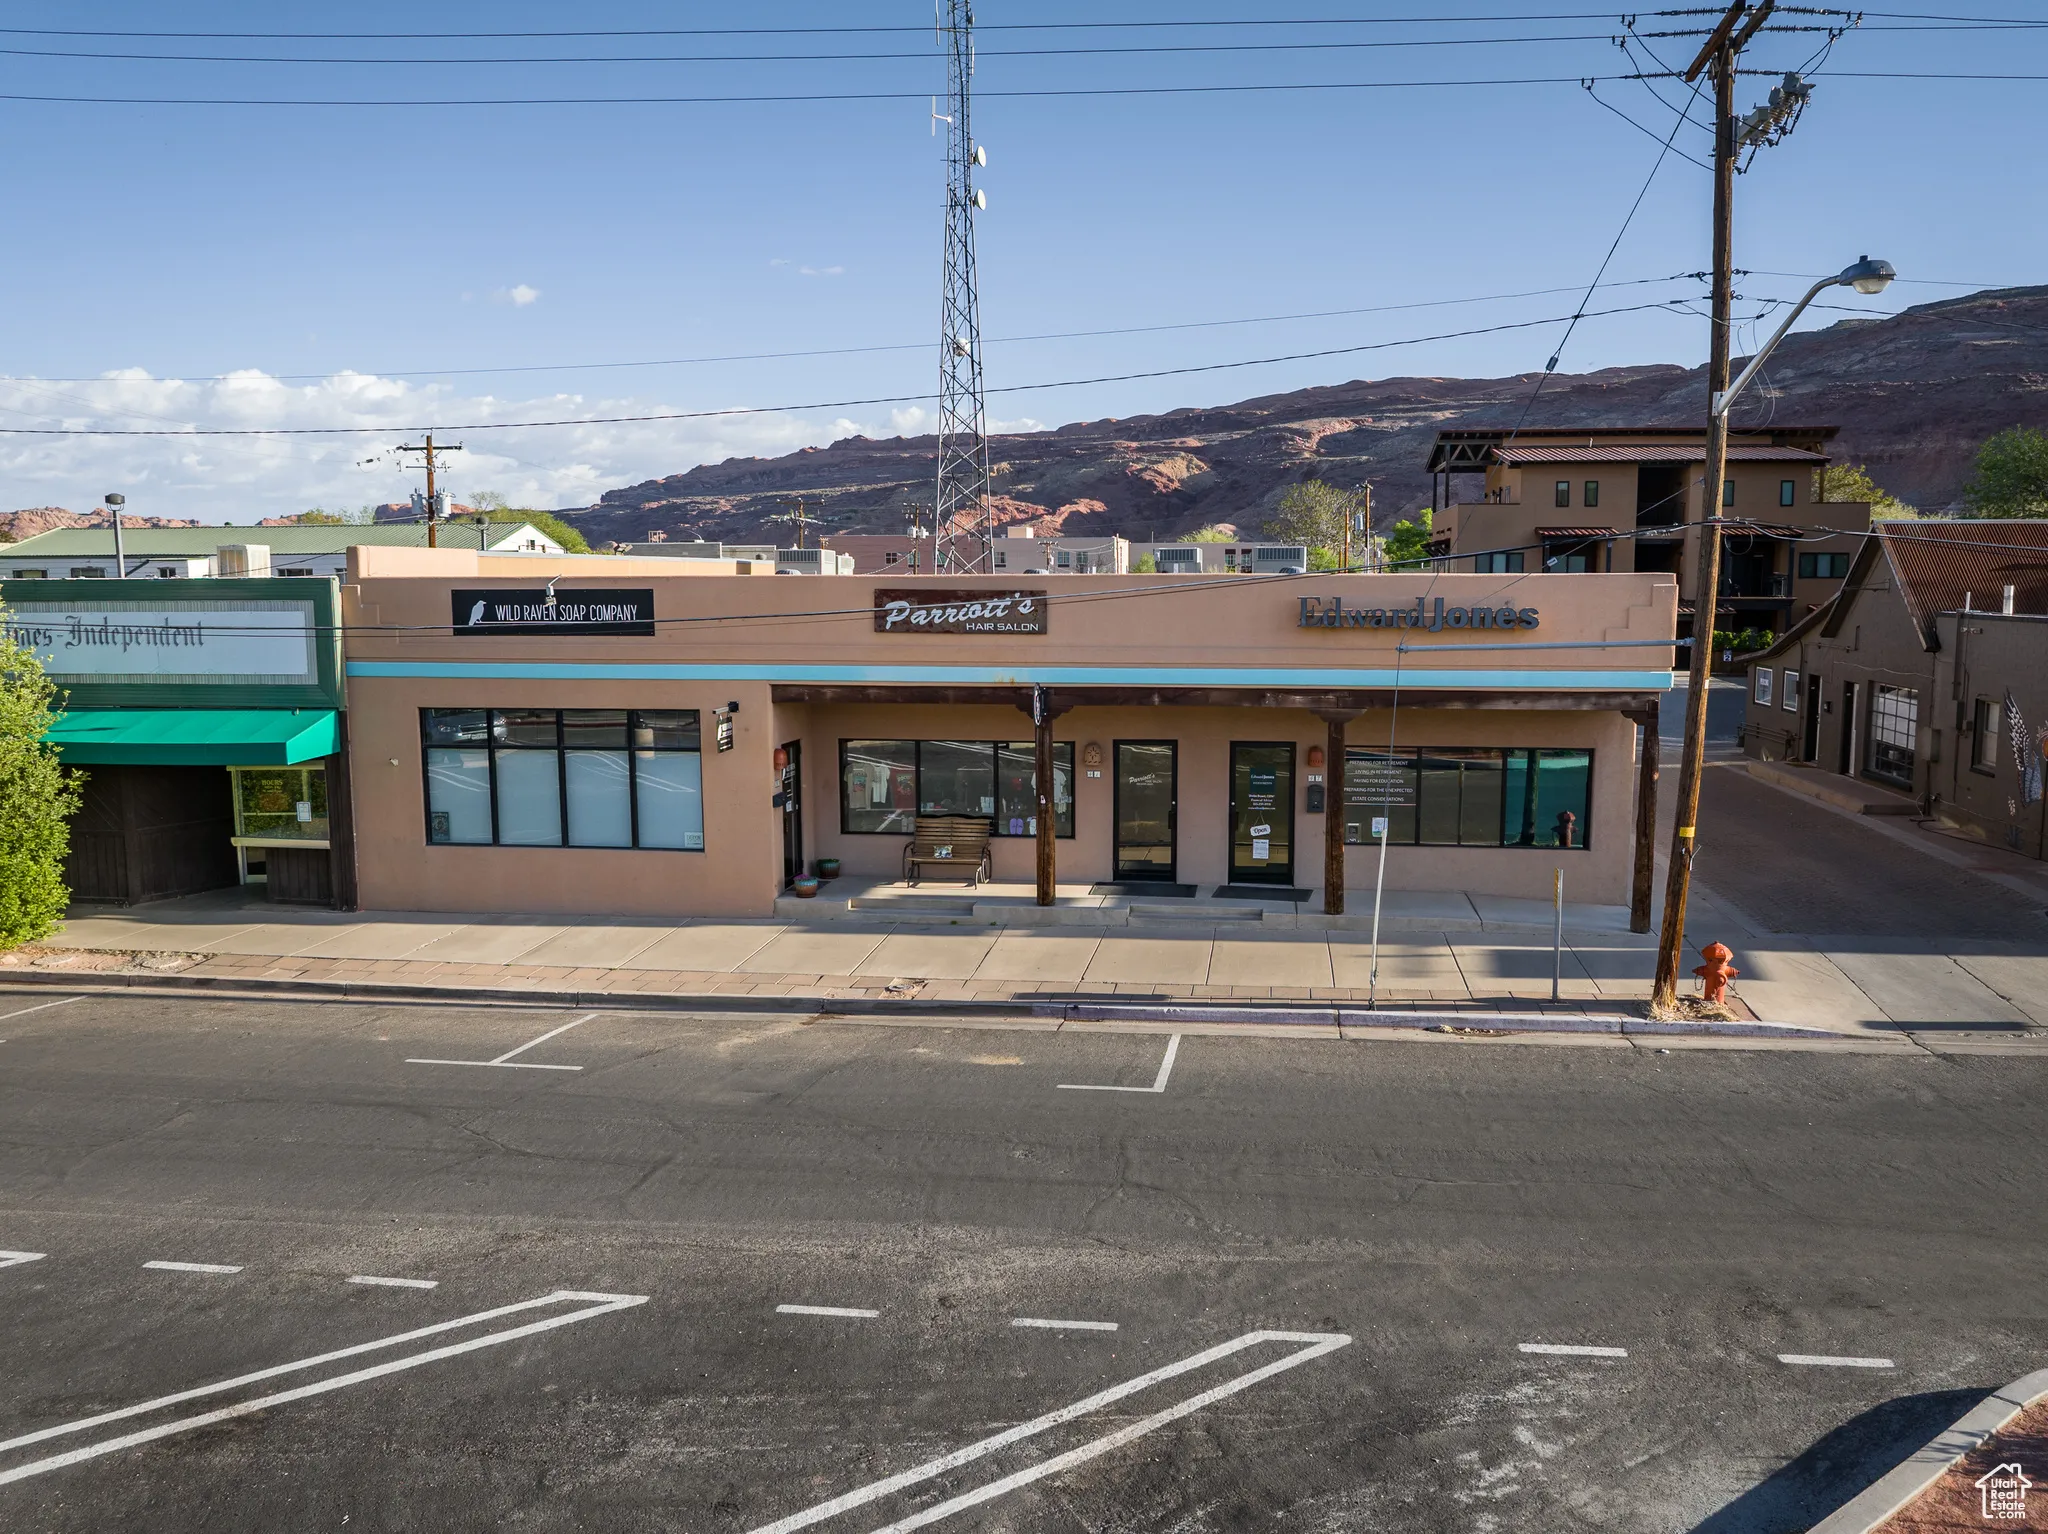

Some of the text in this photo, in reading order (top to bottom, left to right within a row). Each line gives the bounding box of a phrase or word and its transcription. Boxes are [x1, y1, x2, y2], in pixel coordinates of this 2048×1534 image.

[495, 604, 637, 621] WILD RAVEN SOAP COMPANY
[885, 593, 1035, 630] Parriott's
[966, 623, 1039, 631] HAIR SALON
